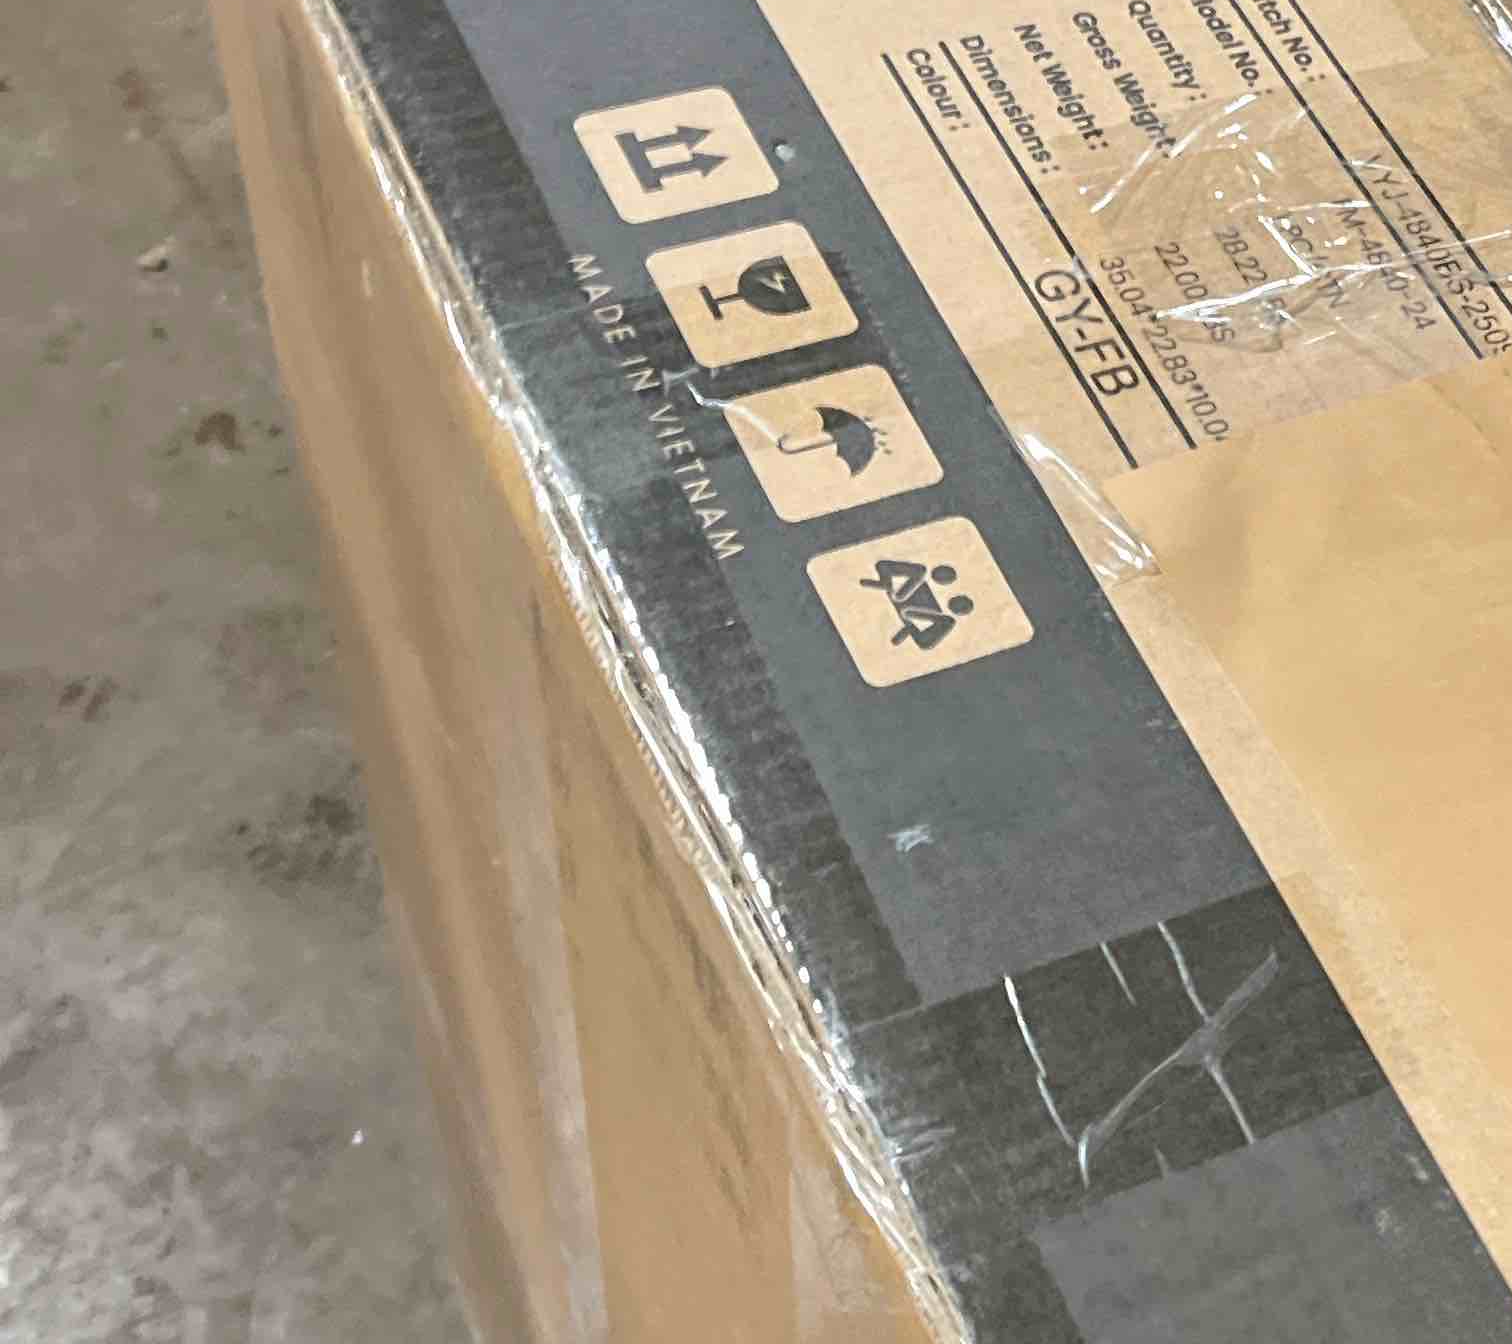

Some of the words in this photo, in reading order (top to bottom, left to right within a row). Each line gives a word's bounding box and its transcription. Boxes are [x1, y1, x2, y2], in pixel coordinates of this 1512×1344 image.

[1013, 23, 1055, 63] Net
[1072, 11, 1121, 70] Gross
[1031, 266, 1139, 398] GY-FB
[1100, 256, 1229, 441] 35.0422.8310.0
[569, 254, 637, 344] MADE
[621, 355, 660, 393] IN
[648, 404, 744, 560] VIETNAM
